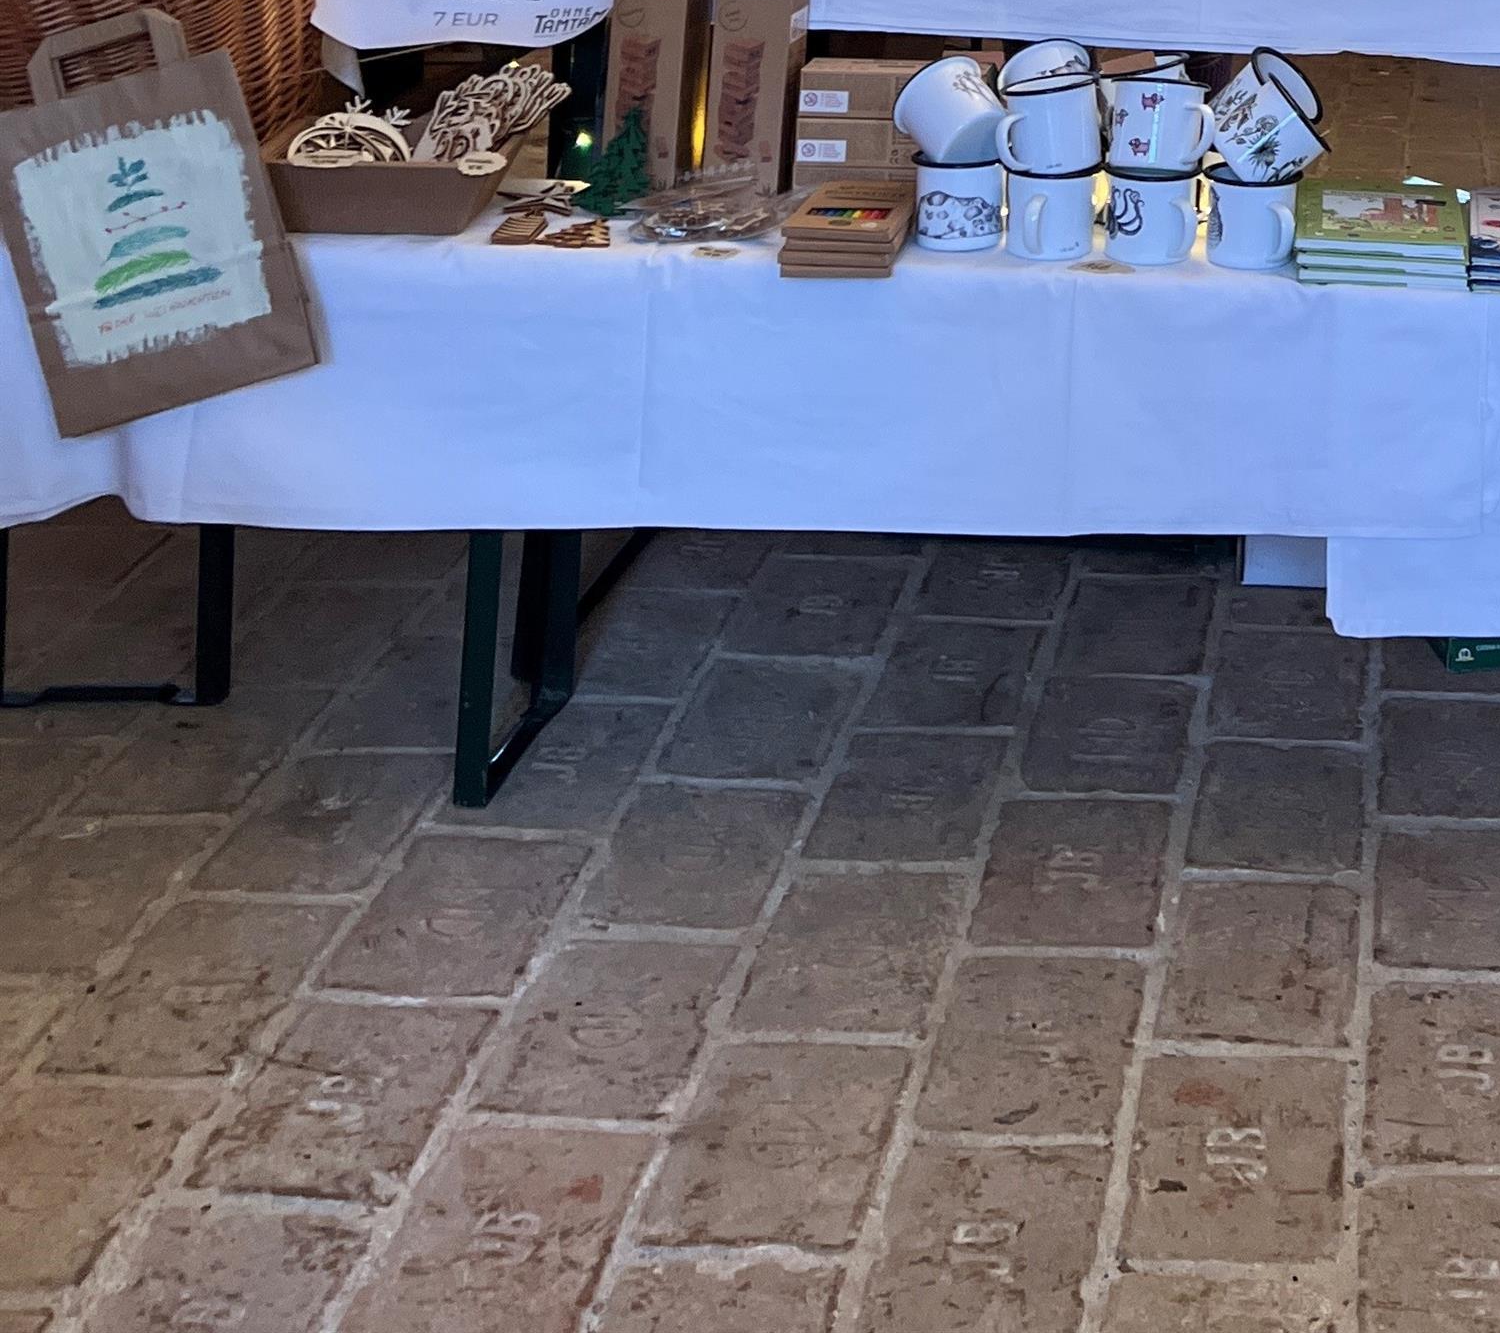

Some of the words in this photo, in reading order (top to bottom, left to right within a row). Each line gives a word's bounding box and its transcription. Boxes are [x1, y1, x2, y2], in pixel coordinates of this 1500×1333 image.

[433, 12, 445, 27] 7
[451, 13, 499, 27] EUR
[550, 6, 593, 18] OHNE
[1437, 1044, 1497, 1094] JB
[1205, 1127, 1269, 1186] JB
